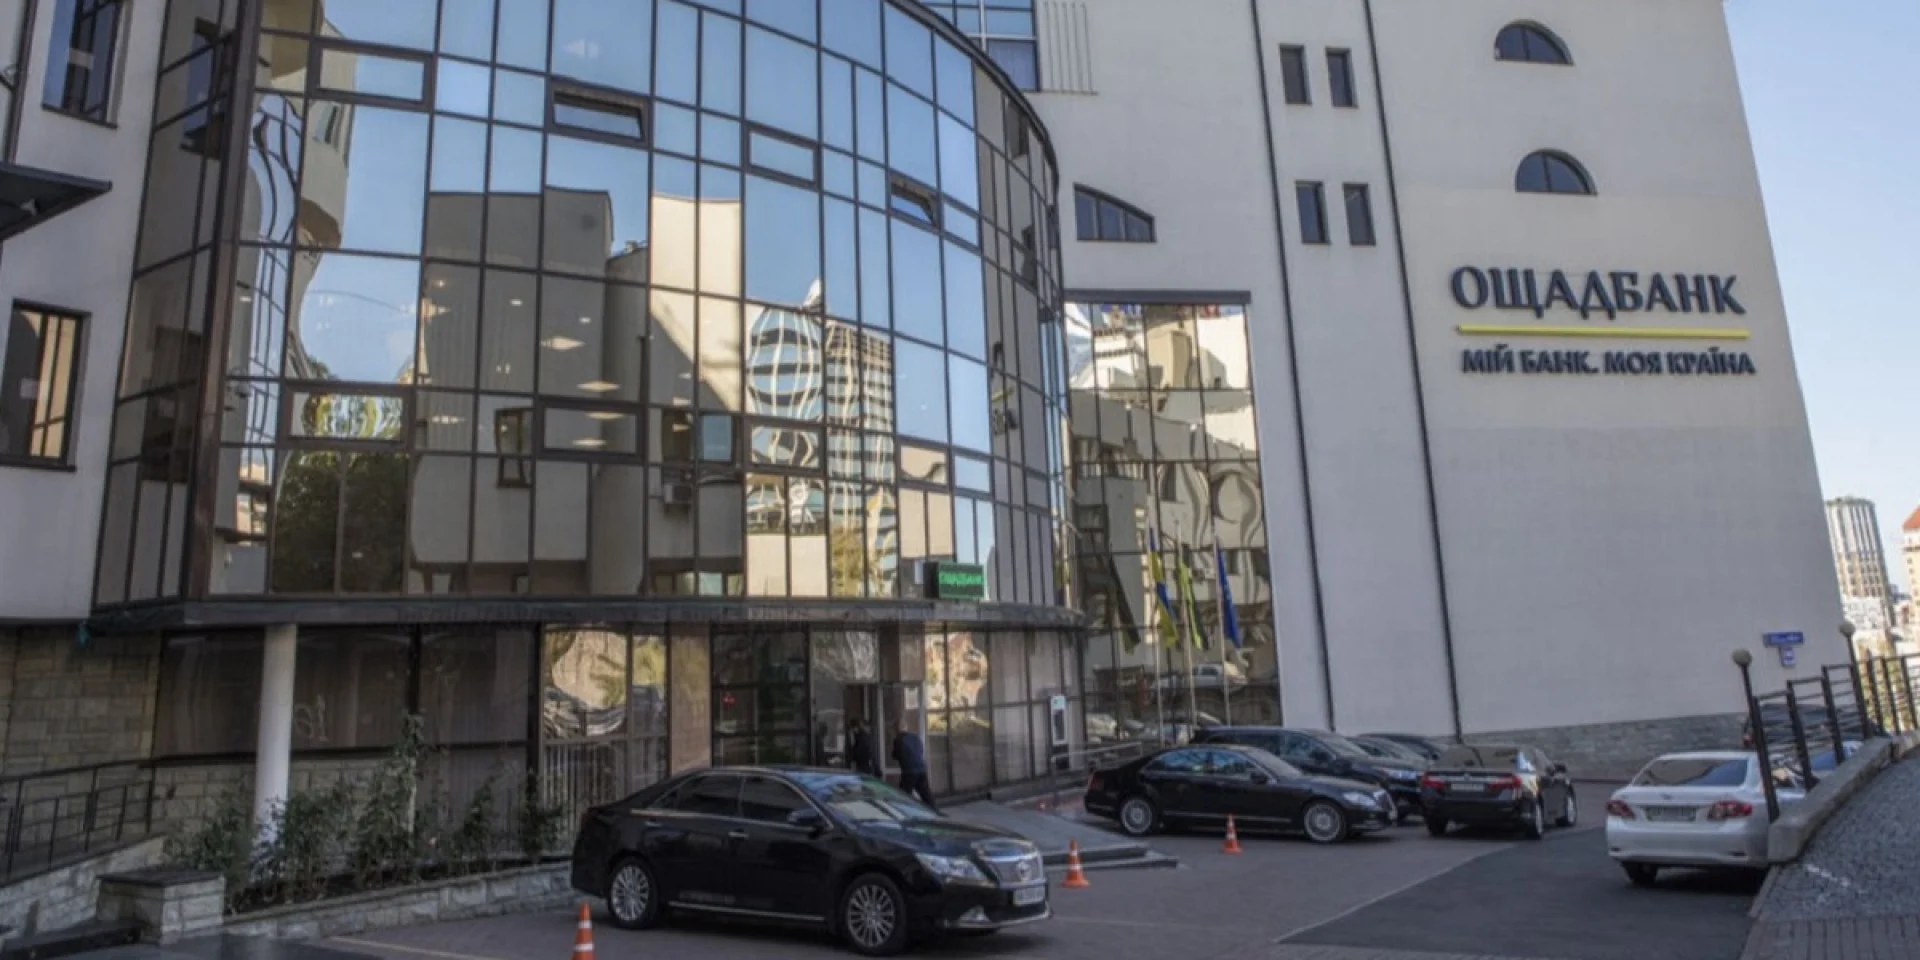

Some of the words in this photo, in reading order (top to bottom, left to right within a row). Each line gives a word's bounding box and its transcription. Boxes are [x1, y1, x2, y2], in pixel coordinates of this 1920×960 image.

[1451, 266, 1746, 320] ОЩАДБАНК
[1461, 344, 1515, 374] МІЙ
[1520, 350, 1598, 375] БАНК.
[1604, 350, 1662, 375] МОЯ
[1667, 346, 1756, 375] КРАЇНА
